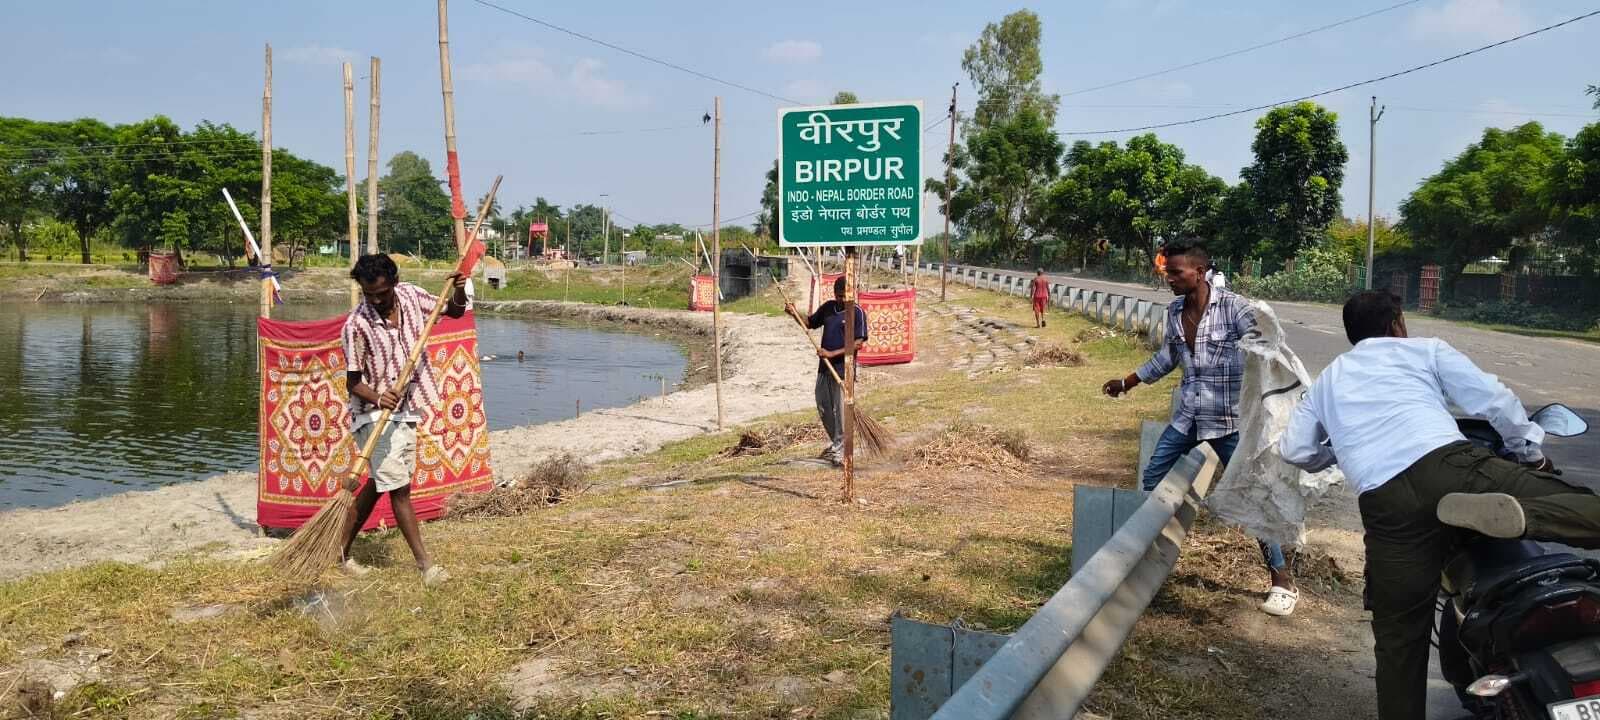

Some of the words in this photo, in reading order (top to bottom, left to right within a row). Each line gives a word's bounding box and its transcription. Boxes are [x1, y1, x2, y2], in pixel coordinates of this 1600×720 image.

[797, 112, 904, 152] वीरपुर
[795, 157, 905, 183] BIRPUR
[787, 190, 809, 203] INDO
[816, 189, 844, 202] NEPAL
[847, 188, 885, 201] BORDER
[887, 186, 914, 200] ROAD
[791, 205, 813, 222] इंडो
[818, 205, 851, 220] नेपाल
[856, 203, 886, 219] बोर्डर
[891, 207, 911, 218] पथ
